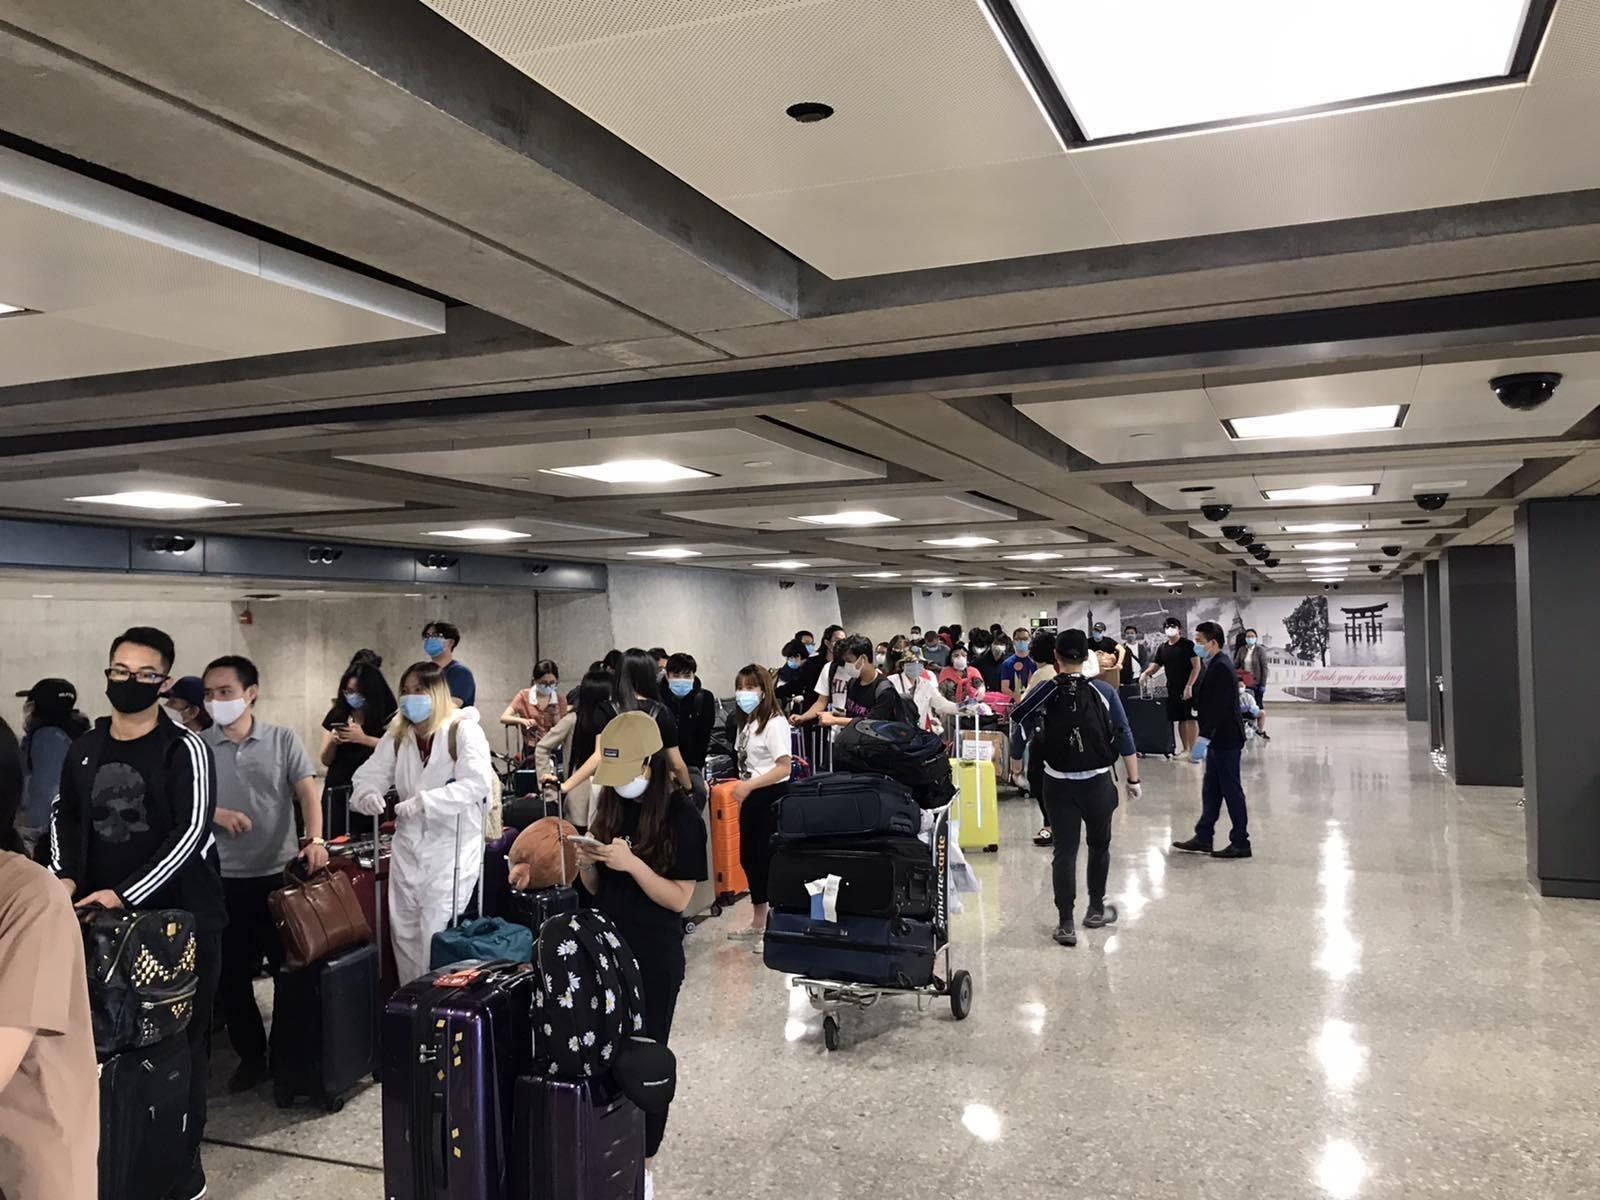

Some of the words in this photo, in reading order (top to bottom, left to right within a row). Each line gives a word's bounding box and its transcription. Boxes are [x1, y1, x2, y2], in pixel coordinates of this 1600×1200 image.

[1303, 669, 1336, 681] Thank
[1336, 675, 1353, 685] you
[1352, 667, 1368, 685] for
[1369, 671, 1403, 685] visiting
